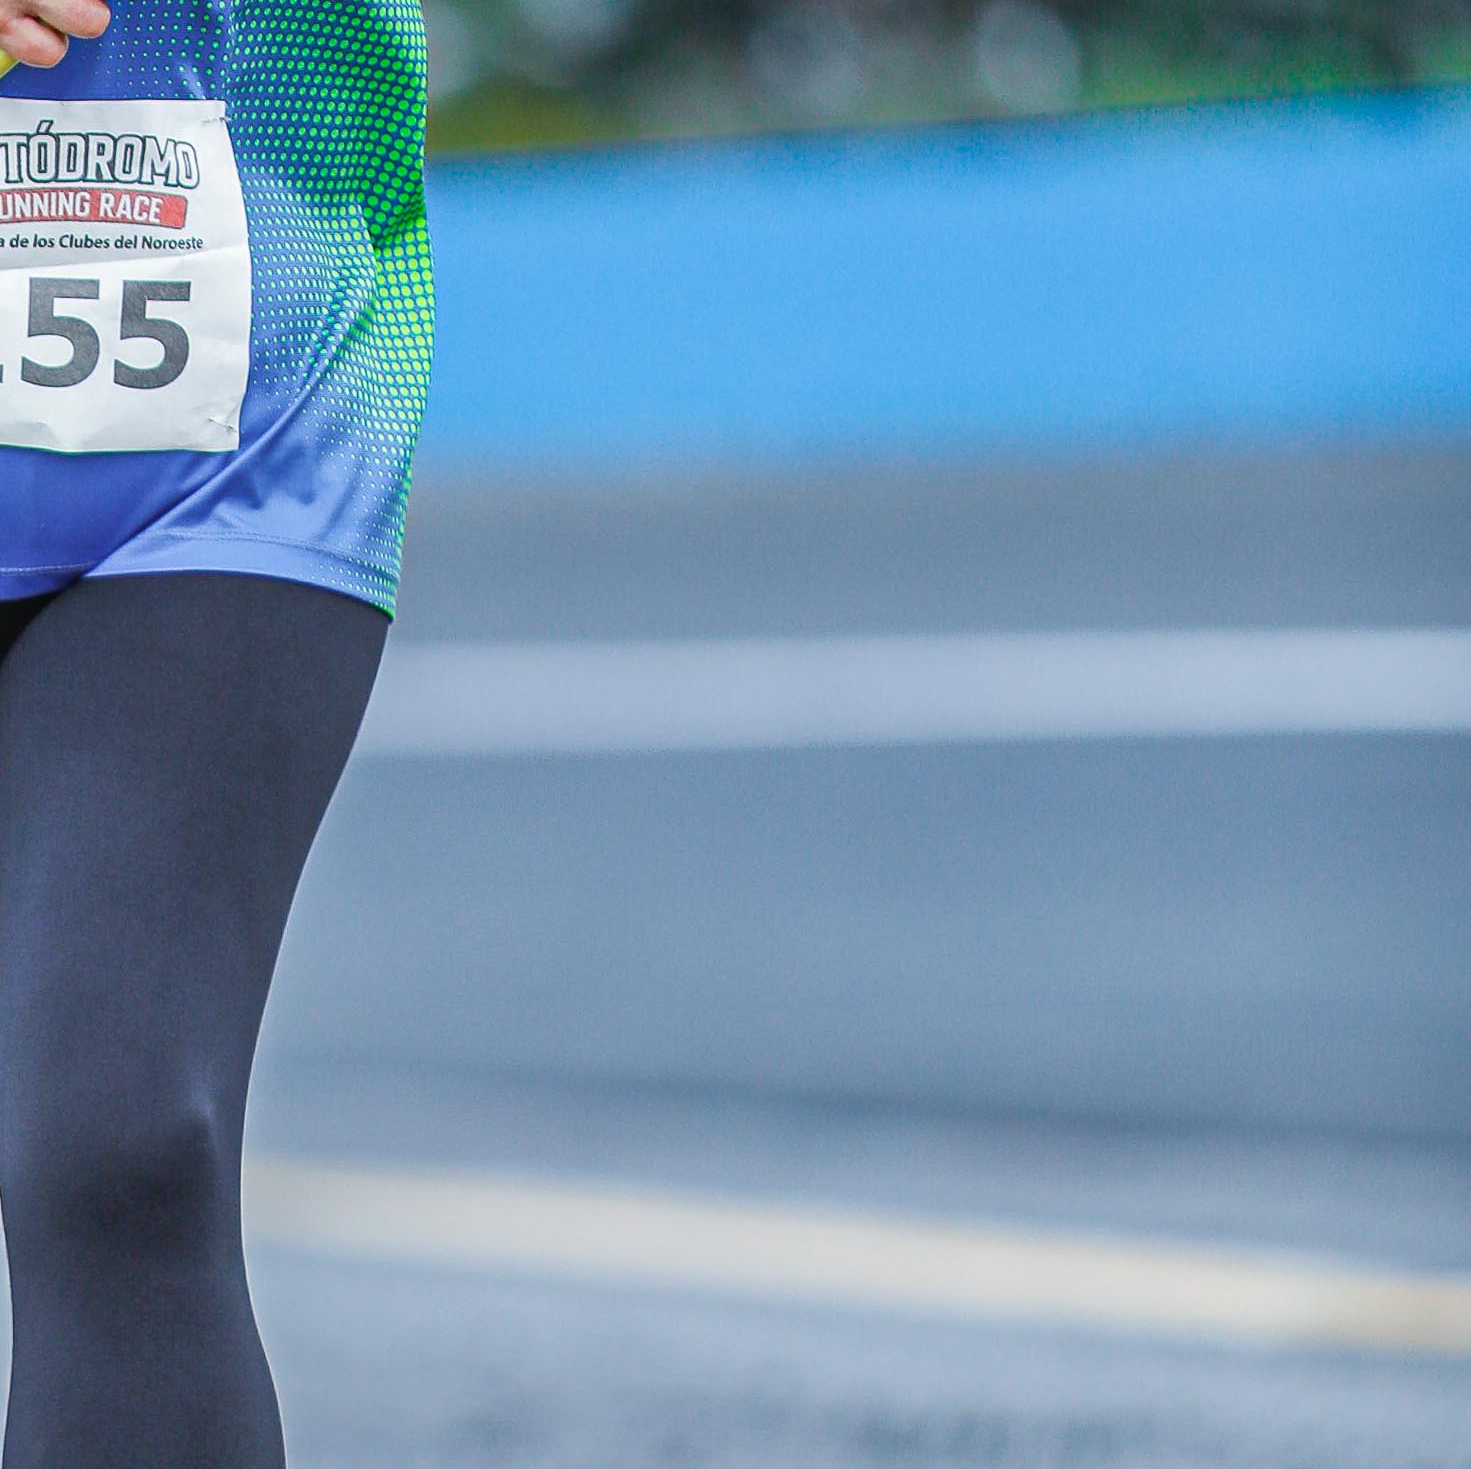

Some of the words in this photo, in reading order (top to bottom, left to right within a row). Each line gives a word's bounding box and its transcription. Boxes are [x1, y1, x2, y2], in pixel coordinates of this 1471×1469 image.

[99, 192, 164, 224] RACE
[9, 233, 29, 248] de
[33, 233, 55, 249] los
[58, 234, 110, 249] Clubes
[114, 235, 137, 250] del
[141, 235, 204, 250] Noroeste
